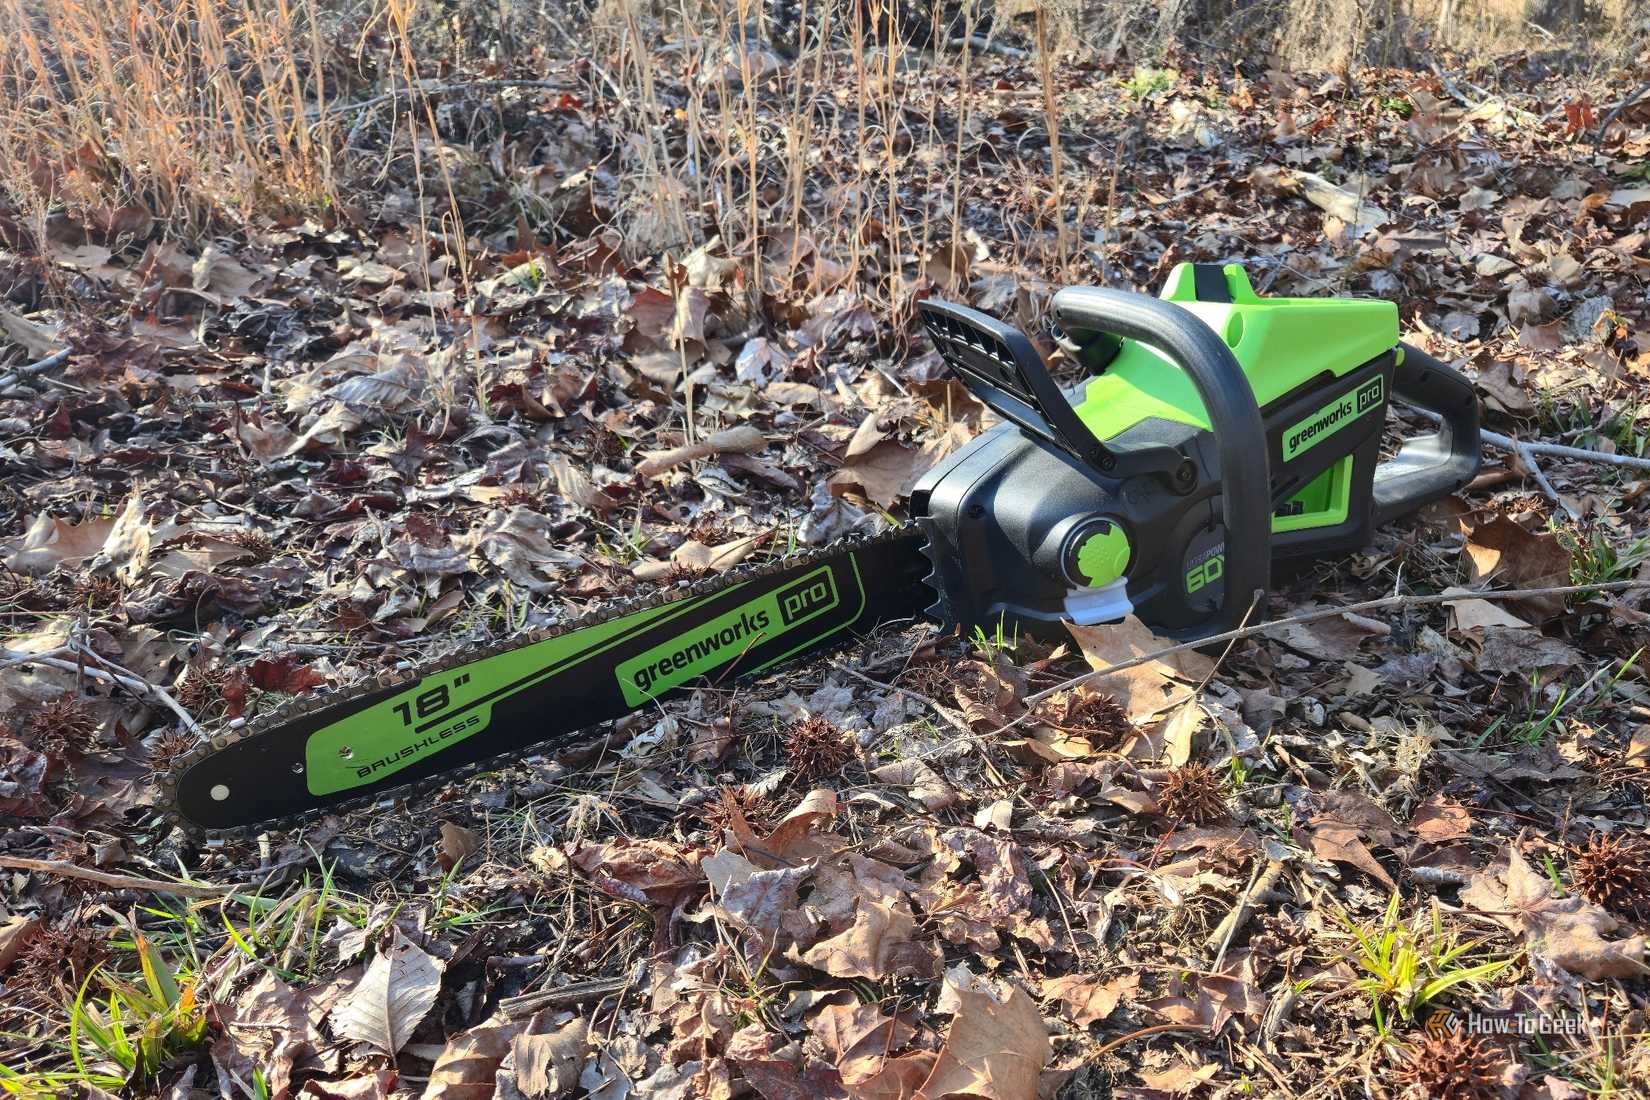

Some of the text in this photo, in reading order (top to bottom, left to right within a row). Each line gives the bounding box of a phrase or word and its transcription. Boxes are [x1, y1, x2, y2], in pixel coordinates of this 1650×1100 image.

[1289, 385, 1380, 453] greenworks pro
[633, 581, 828, 694] greenworks pro
[392, 673, 470, 727] 18"
[356, 714, 480, 778] BRUSHLESS
